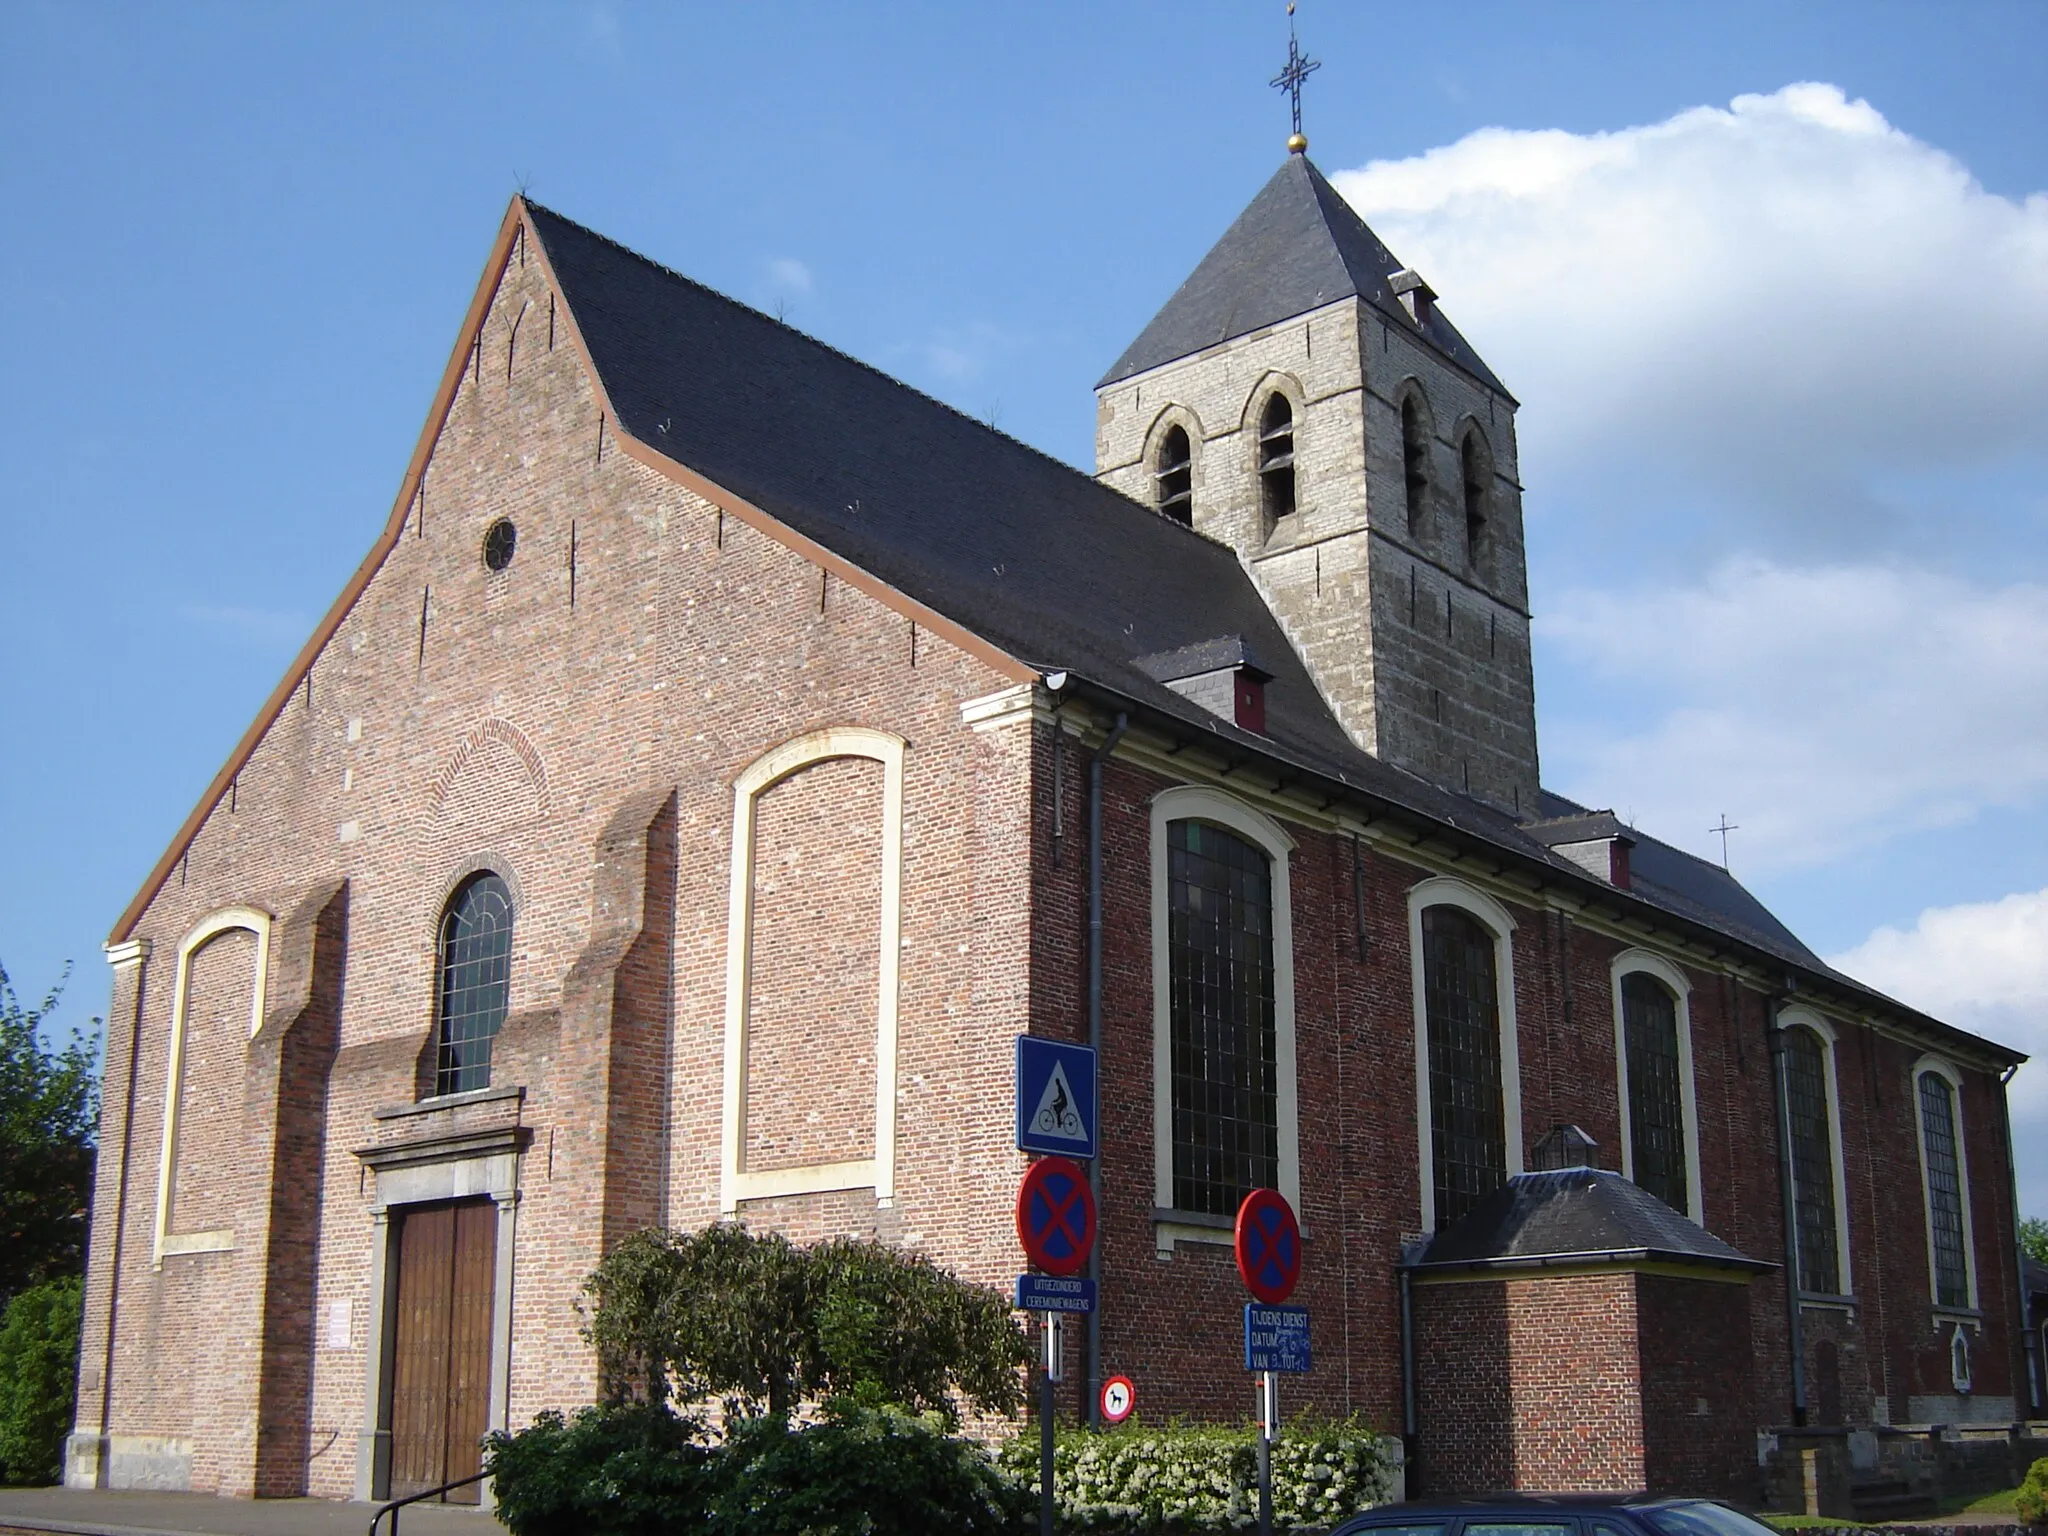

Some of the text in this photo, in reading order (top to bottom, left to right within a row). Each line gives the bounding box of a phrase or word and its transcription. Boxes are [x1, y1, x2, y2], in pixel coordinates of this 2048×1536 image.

[1034, 1278, 1082, 1293] UITGEZONDERD
[1026, 1295, 1089, 1311] CEREMONIEWAGENS
[1251, 1310, 1308, 1328] TIJDENS DIENST
[1251, 1331, 1278, 1348] DATUM
[1252, 1353, 1268, 1369] VAN
[1281, 1354, 1296, 1369] TOT
